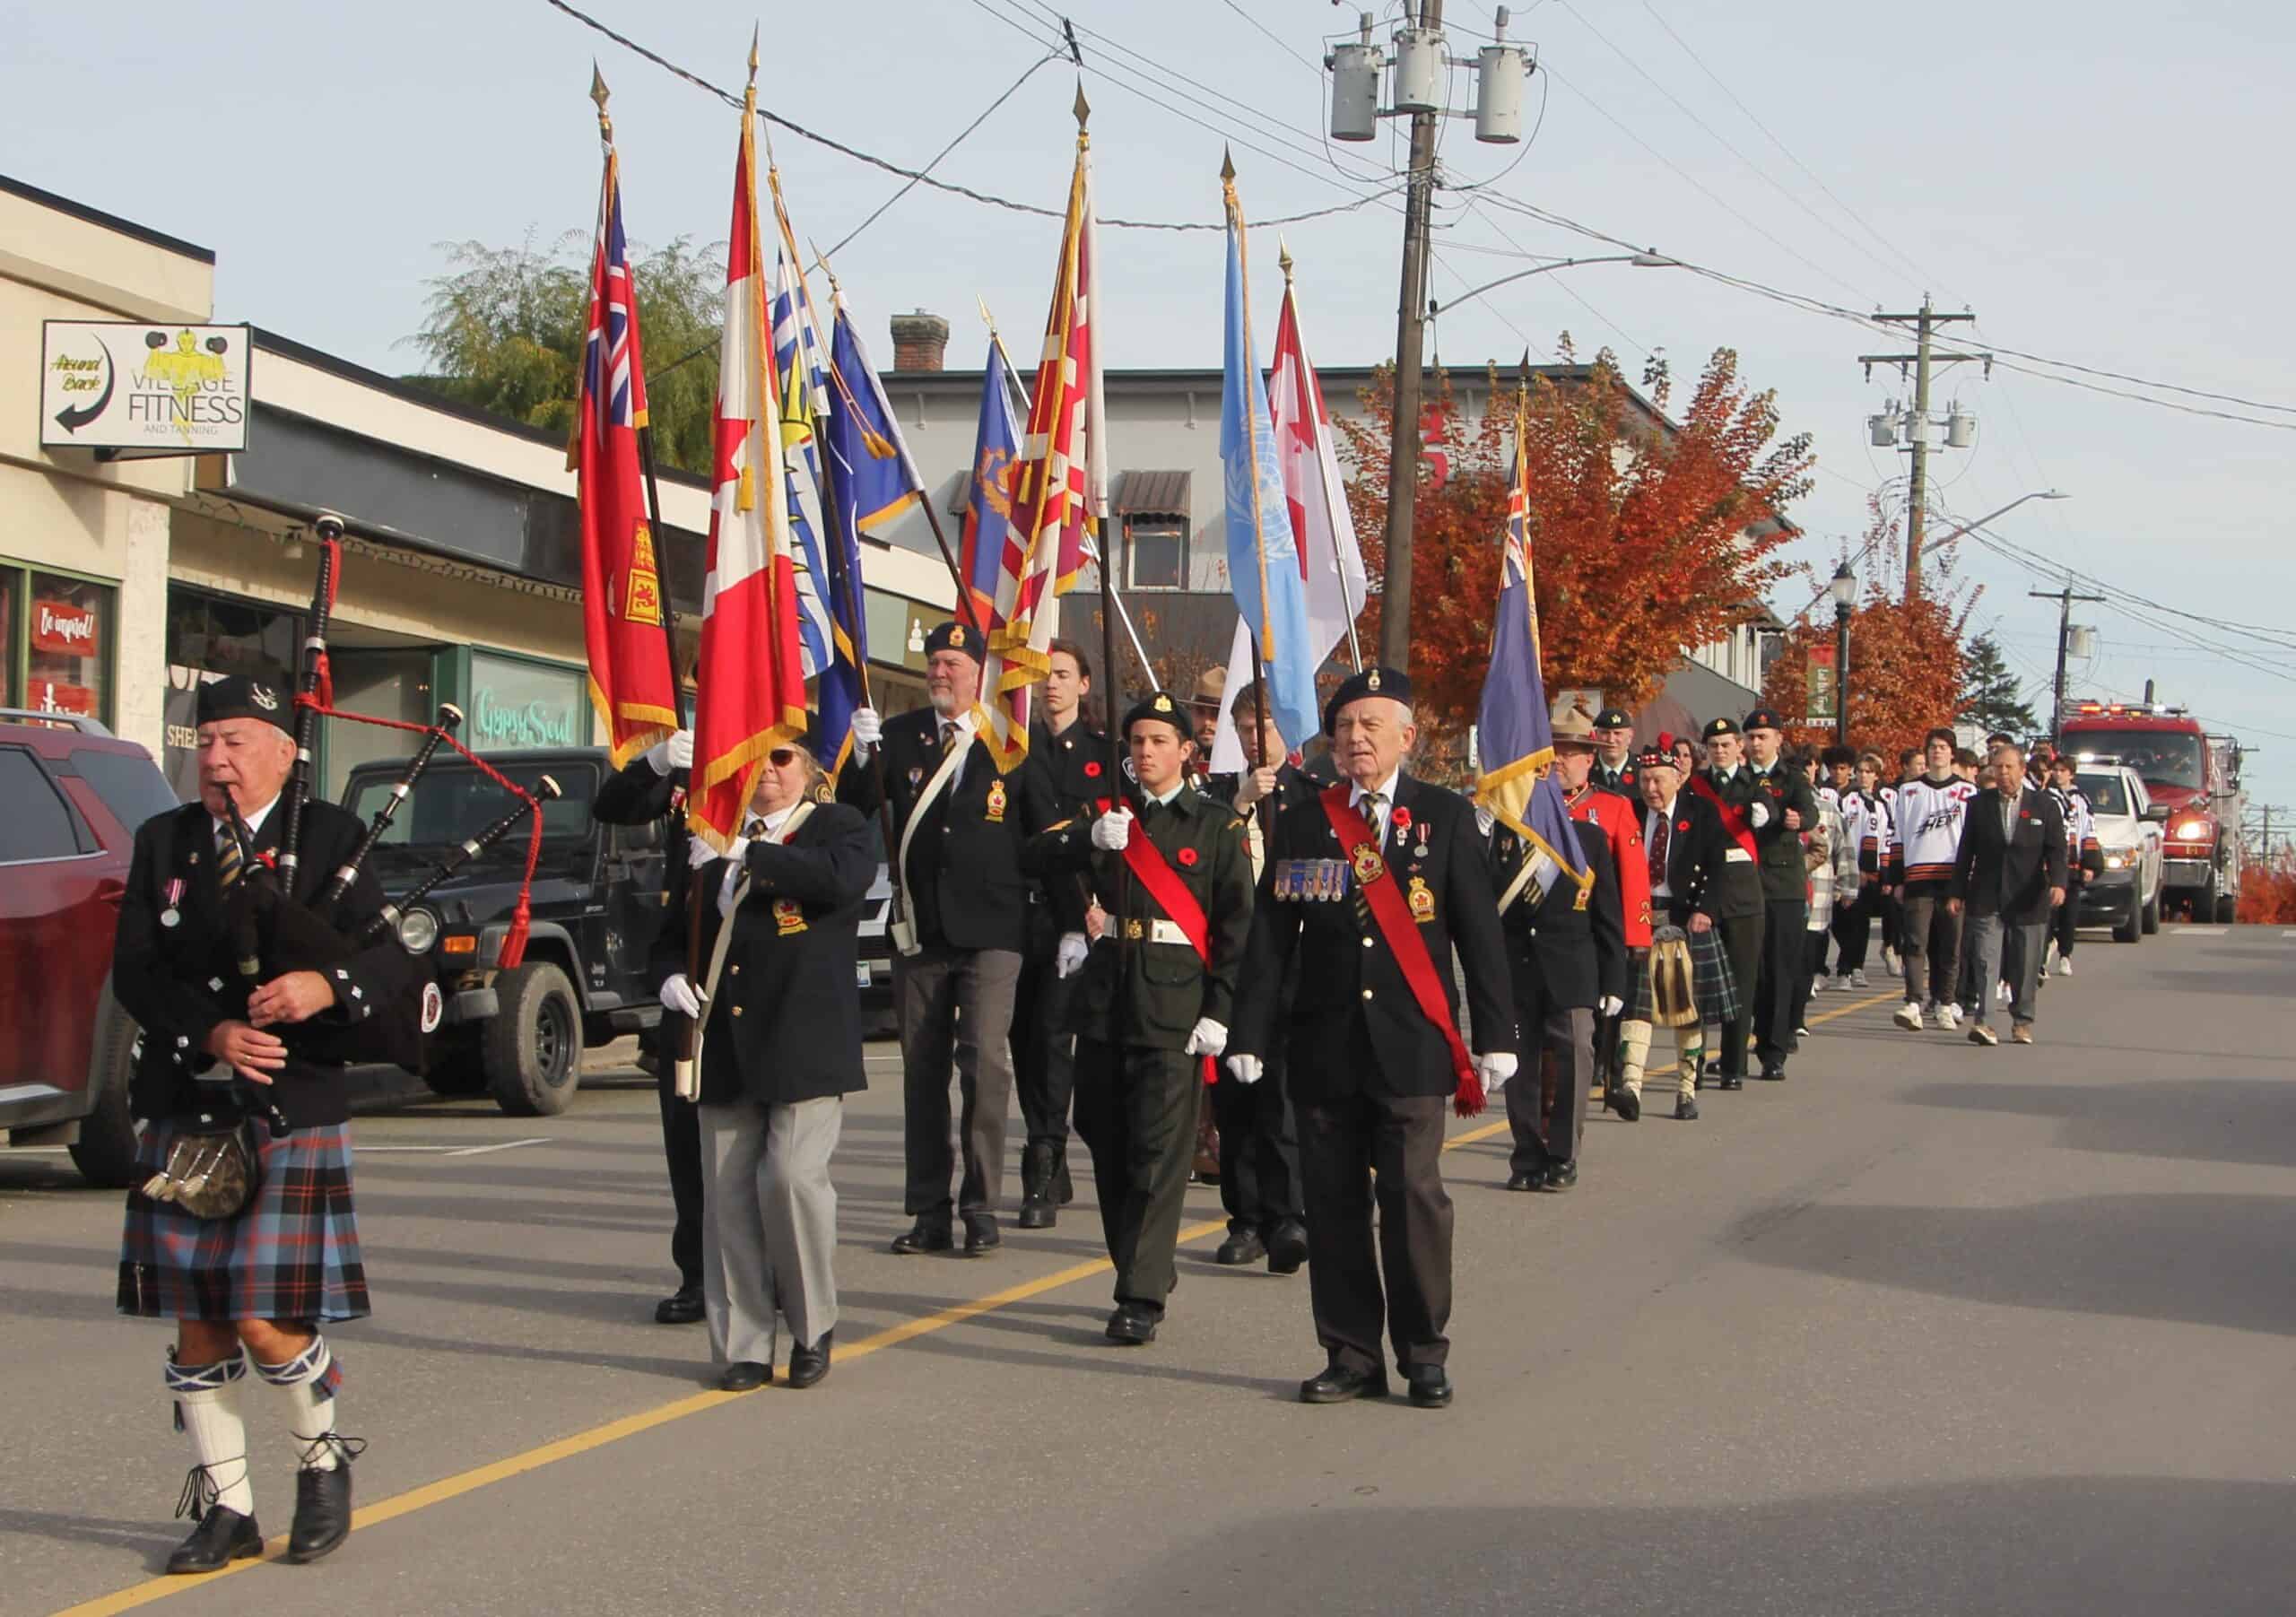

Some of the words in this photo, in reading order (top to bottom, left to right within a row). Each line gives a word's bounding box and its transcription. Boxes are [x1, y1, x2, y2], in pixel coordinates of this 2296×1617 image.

[50, 353, 104, 371] Around
[62, 373, 100, 391] Back
[128, 393, 243, 424] FITNESS
[144, 422, 168, 435] AND
[170, 424, 218, 436] TANNING
[480, 687, 528, 743] Gypsy
[529, 700, 575, 747] Soul
